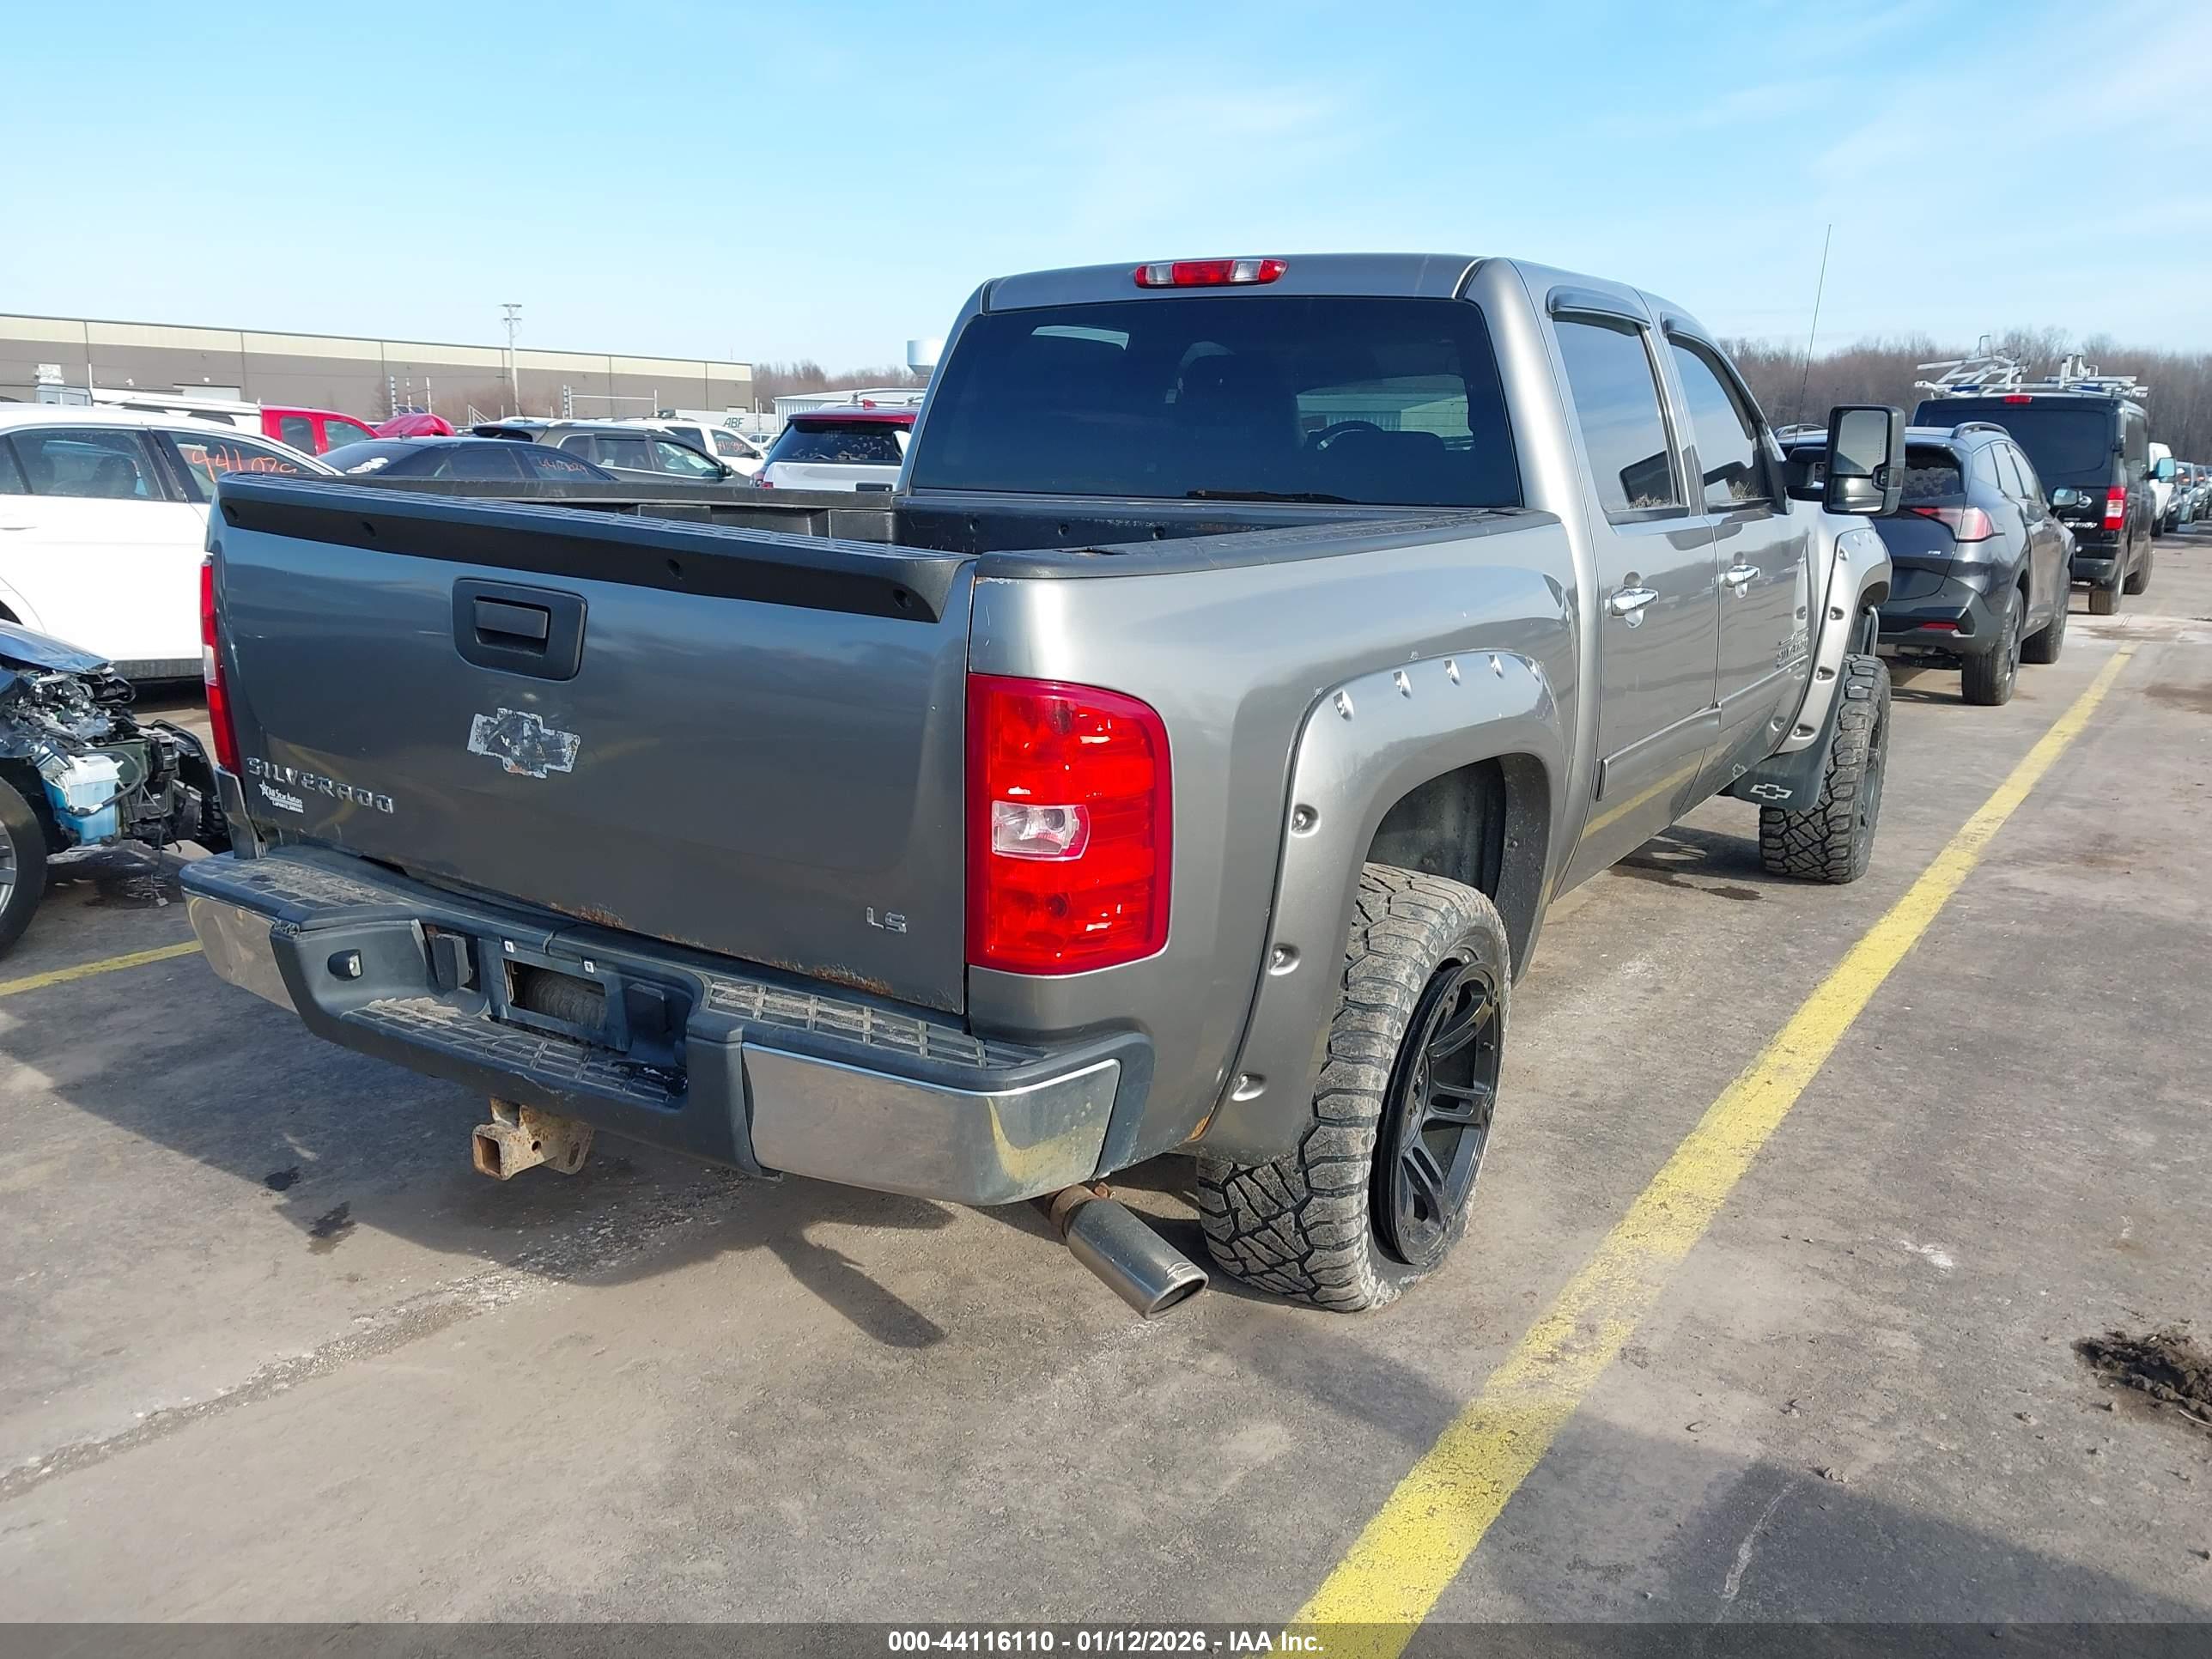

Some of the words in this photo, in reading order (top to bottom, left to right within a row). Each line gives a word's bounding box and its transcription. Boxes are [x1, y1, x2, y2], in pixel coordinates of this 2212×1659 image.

[723, 417, 745, 428] ABF
[246, 757, 394, 814] SILVERADO
[866, 906, 907, 933] LS
